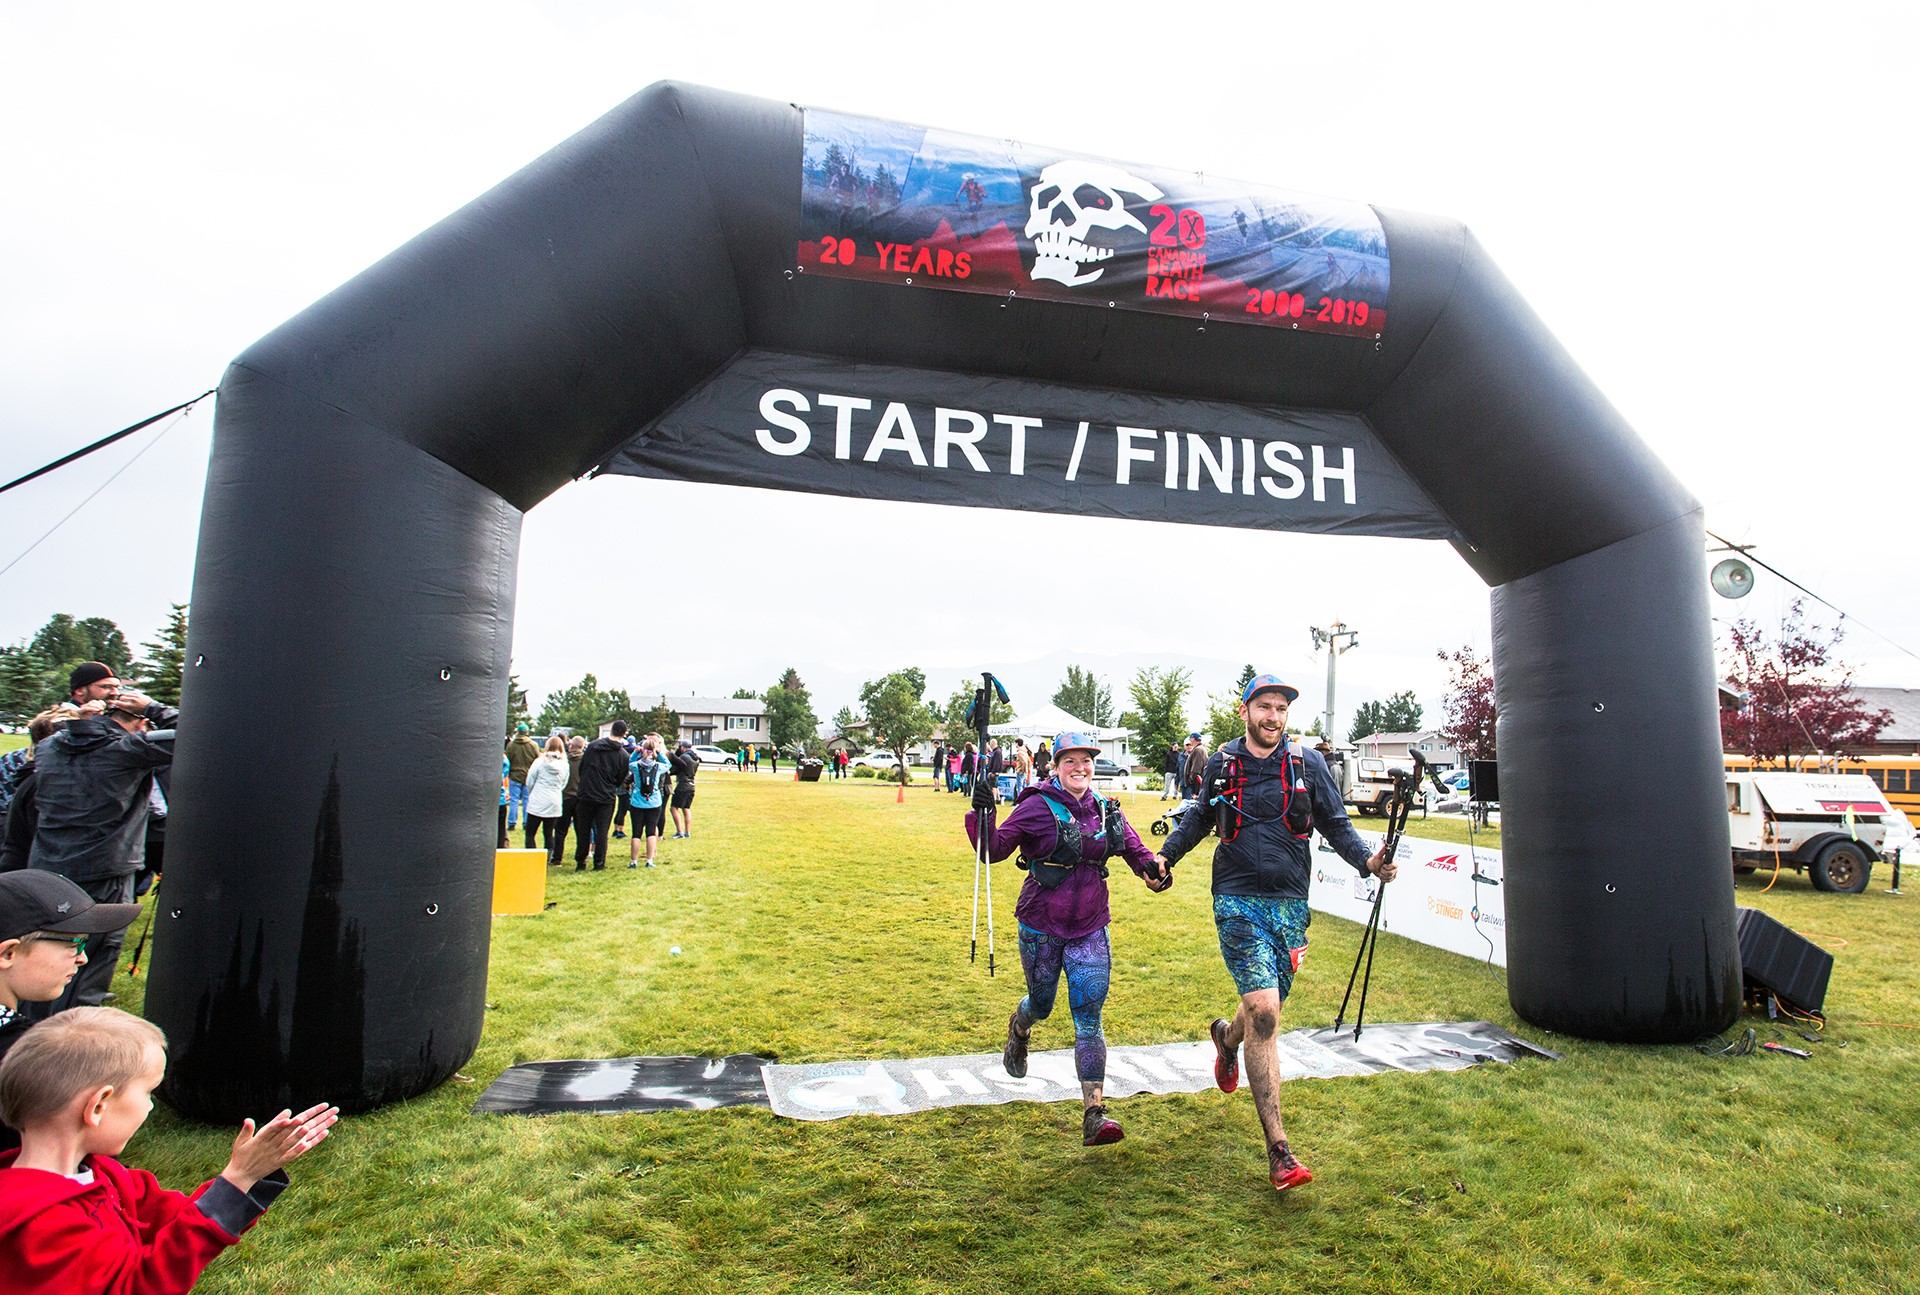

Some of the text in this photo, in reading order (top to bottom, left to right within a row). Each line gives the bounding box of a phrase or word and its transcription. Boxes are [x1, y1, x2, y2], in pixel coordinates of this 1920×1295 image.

[820, 235, 972, 279] 20 YEARS
[1147, 257, 1204, 280] DEATH
[1148, 247, 1207, 266] CANADIAN
[1146, 275, 1201, 302] RACE
[755, 388, 1356, 505] START / FINISH
[1435, 902, 1464, 921] STINGER
